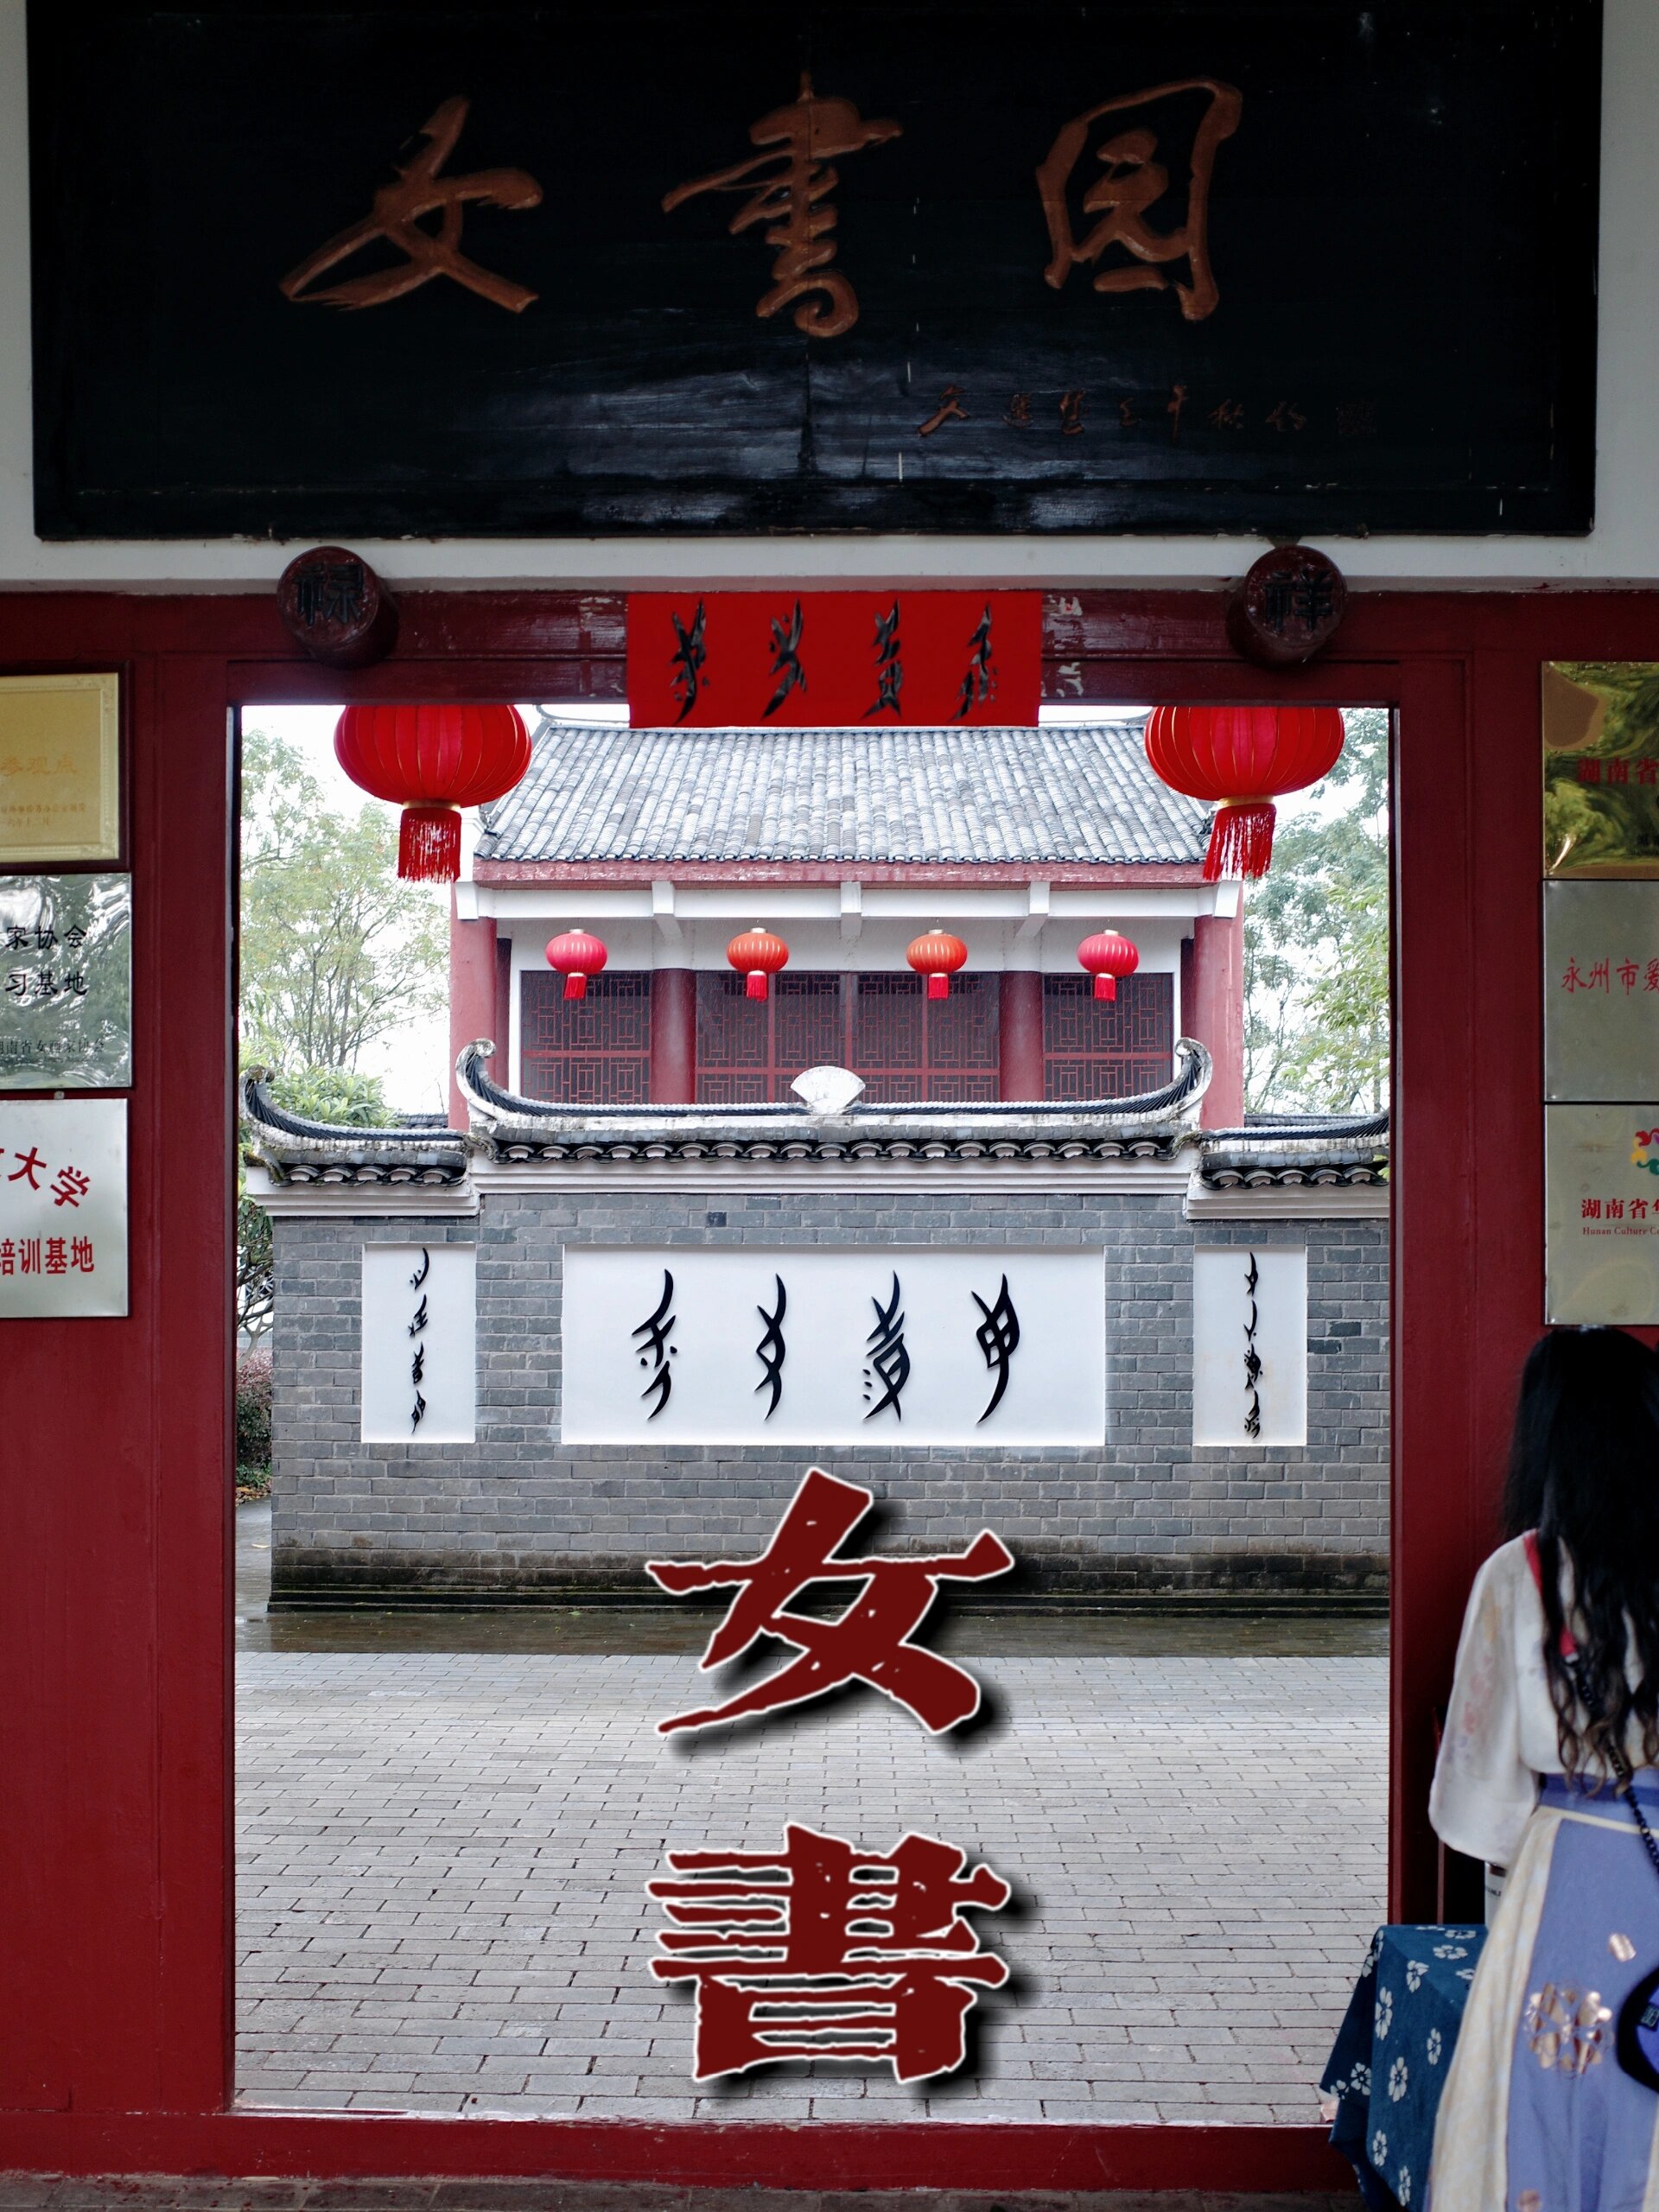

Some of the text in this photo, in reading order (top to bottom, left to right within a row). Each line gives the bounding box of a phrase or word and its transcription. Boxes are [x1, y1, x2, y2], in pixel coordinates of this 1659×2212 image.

[5, 925, 87, 950] 家协会
[5, 970, 88, 995] 习基地
[0, 1147, 90, 1207] 大学
[0, 1236, 94, 1275] 培训基地
